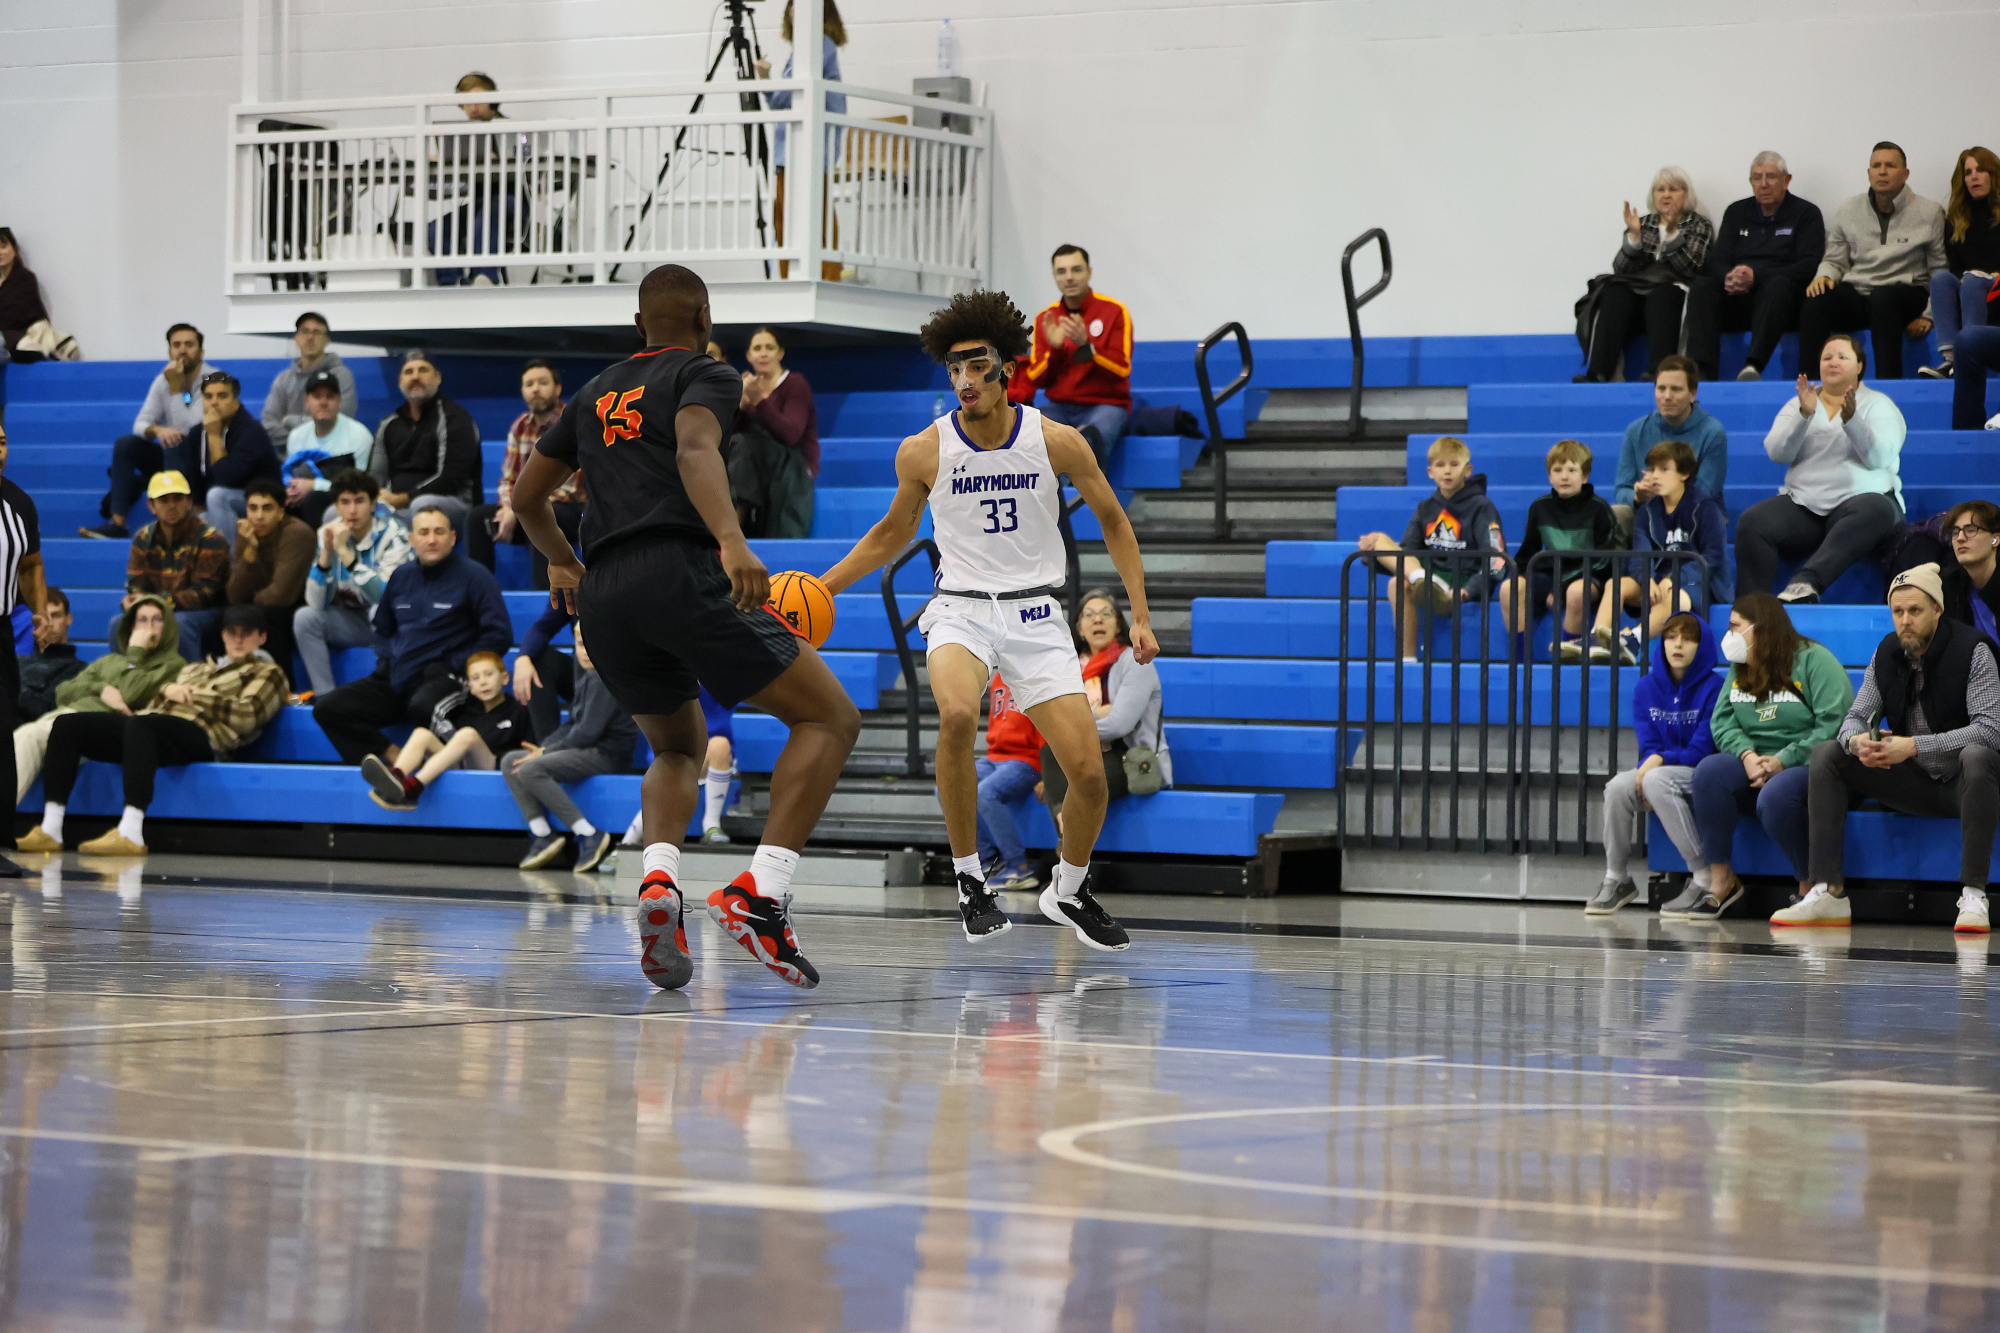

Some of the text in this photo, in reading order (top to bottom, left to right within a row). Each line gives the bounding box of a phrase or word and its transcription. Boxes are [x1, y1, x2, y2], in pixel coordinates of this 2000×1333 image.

[595, 385, 646, 447] 15
[952, 473, 1040, 495] MARYMOUNT
[980, 497, 1018, 534] 33
[1019, 603, 1051, 624] MU
